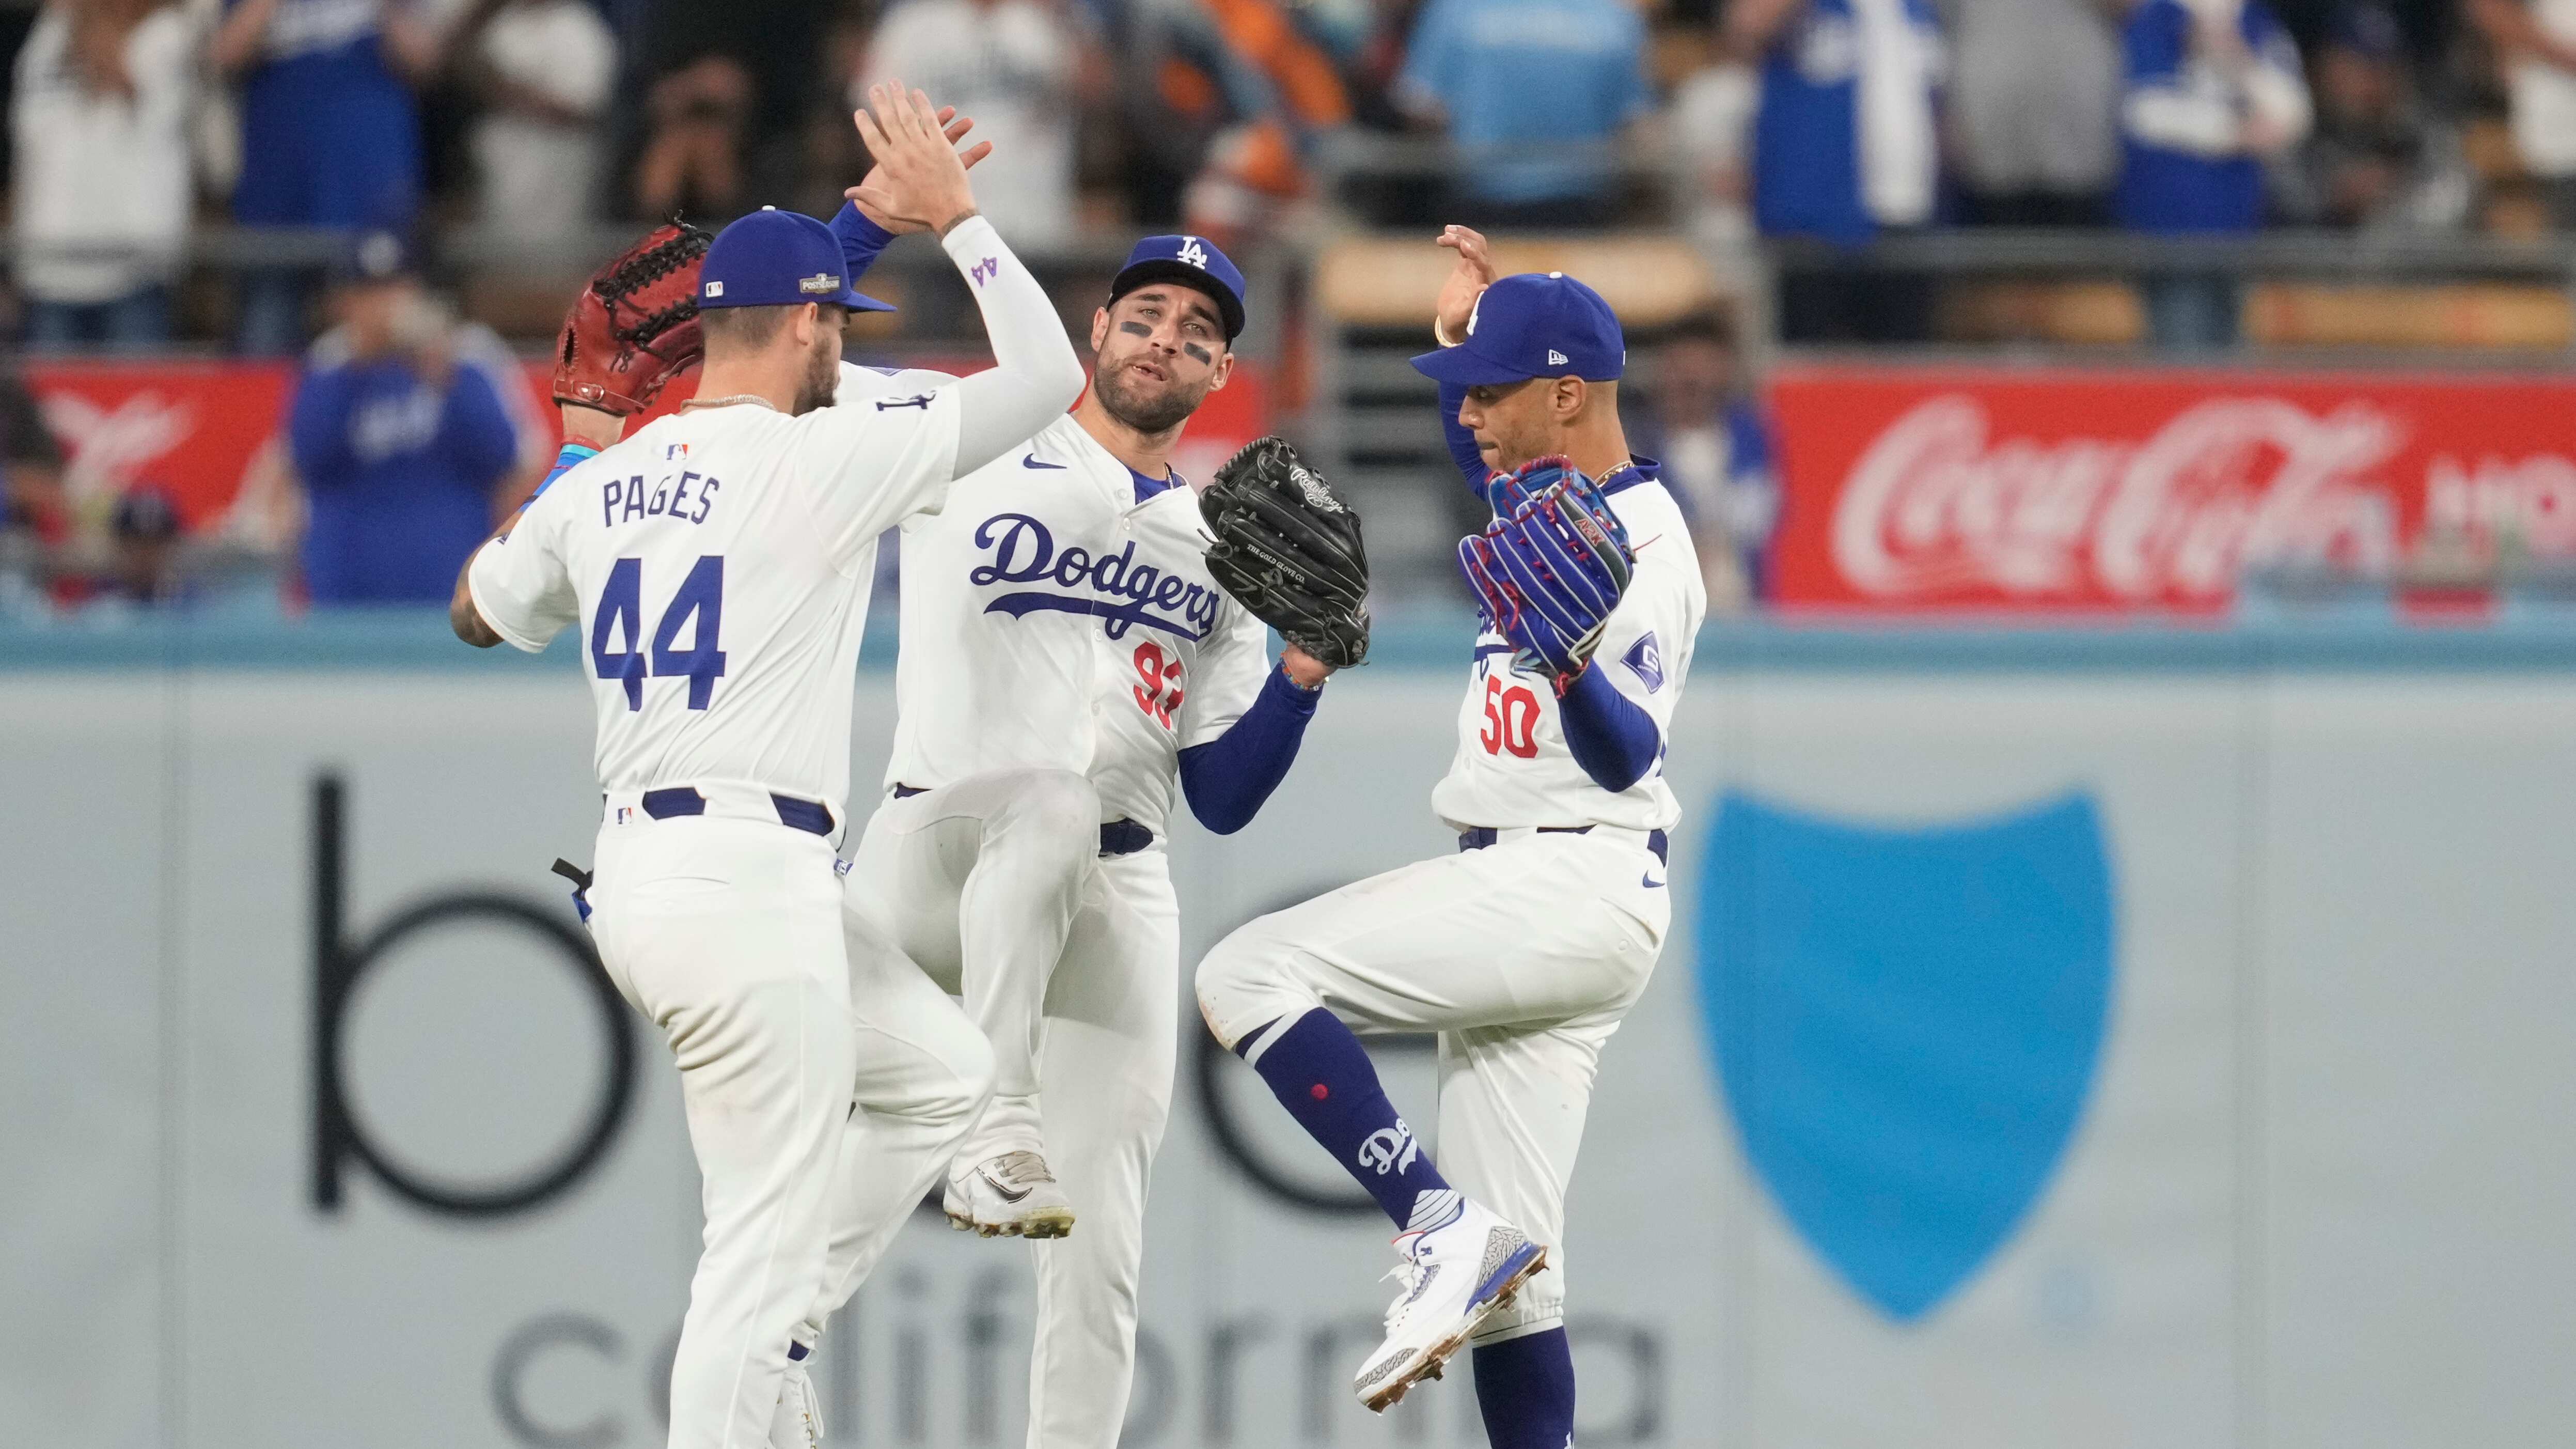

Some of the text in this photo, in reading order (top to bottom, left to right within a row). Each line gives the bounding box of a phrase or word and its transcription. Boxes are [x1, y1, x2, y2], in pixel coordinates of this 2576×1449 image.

[971, 257, 997, 288] 44
[1177, 237, 1207, 270] LA
[603, 471, 719, 527] PAGES
[1291, 468, 1344, 513] Rawlings
[1575, 518, 1605, 547] A2K
[970, 513, 1220, 643] Dodgers
[1247, 543, 1261, 555] THE
[1259, 552, 1277, 565] GOLD
[1276, 561, 1297, 578] GLOVE
[591, 555, 727, 712] 44
[1133, 641, 1185, 731] 93
[1480, 674, 1541, 758] 50
